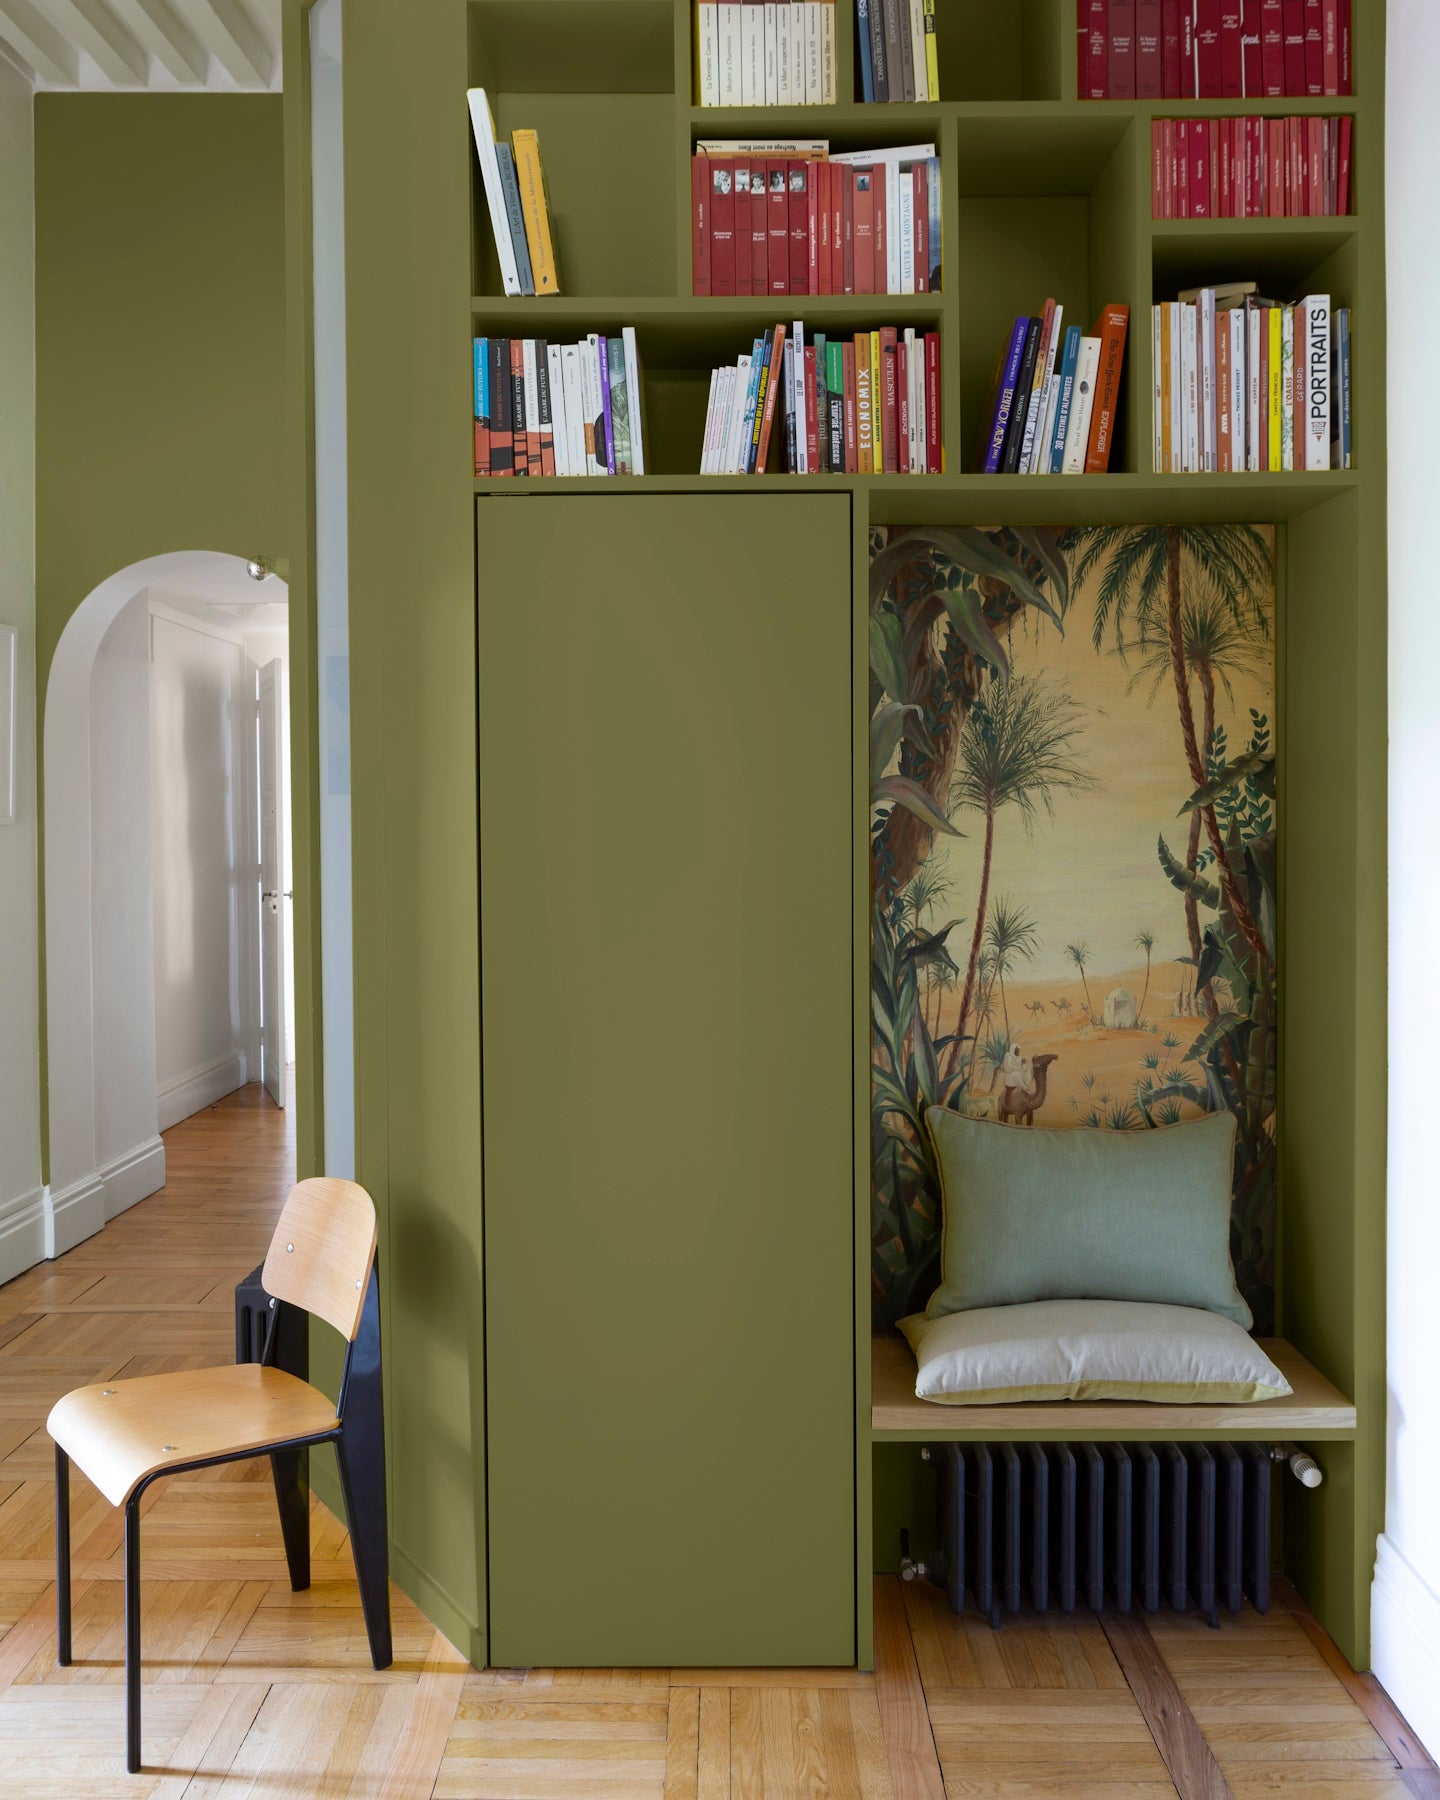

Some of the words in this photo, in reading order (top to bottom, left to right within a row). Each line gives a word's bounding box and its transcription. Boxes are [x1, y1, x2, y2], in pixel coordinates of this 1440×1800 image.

[501, 149, 512, 180] BUREAU
[509, 191, 518, 208] Vivre
[514, 217, 522, 234] L'Art
[904, 238, 911, 246] LA
[538, 241, 546, 269] Voyages
[1311, 309, 1326, 418] PORTRAITS
[759, 366, 768, 397] RÉPUBLIQUE
[886, 358, 894, 405] MASCULIN
[478, 392, 483, 400] DU
[496, 393, 502, 401] DU
[515, 393, 521, 402] DU
[541, 389, 546, 398] DU
[1017, 393, 1025, 414] CHEVAL
[1061, 375, 1073, 414] D'ALPINISTES
[818, 407, 827, 419] jus
[857, 368, 871, 448] ECONOMIX
[997, 387, 1014, 426] YORKER
[818, 422, 828, 439] pur
[1058, 415, 1067, 438] DESTINS
[1097, 410, 1110, 452] EXPLORER
[832, 430, 840, 463] AMÉRICAIN
[993, 427, 1004, 448] NEW
[1055, 440, 1064, 450] 30
